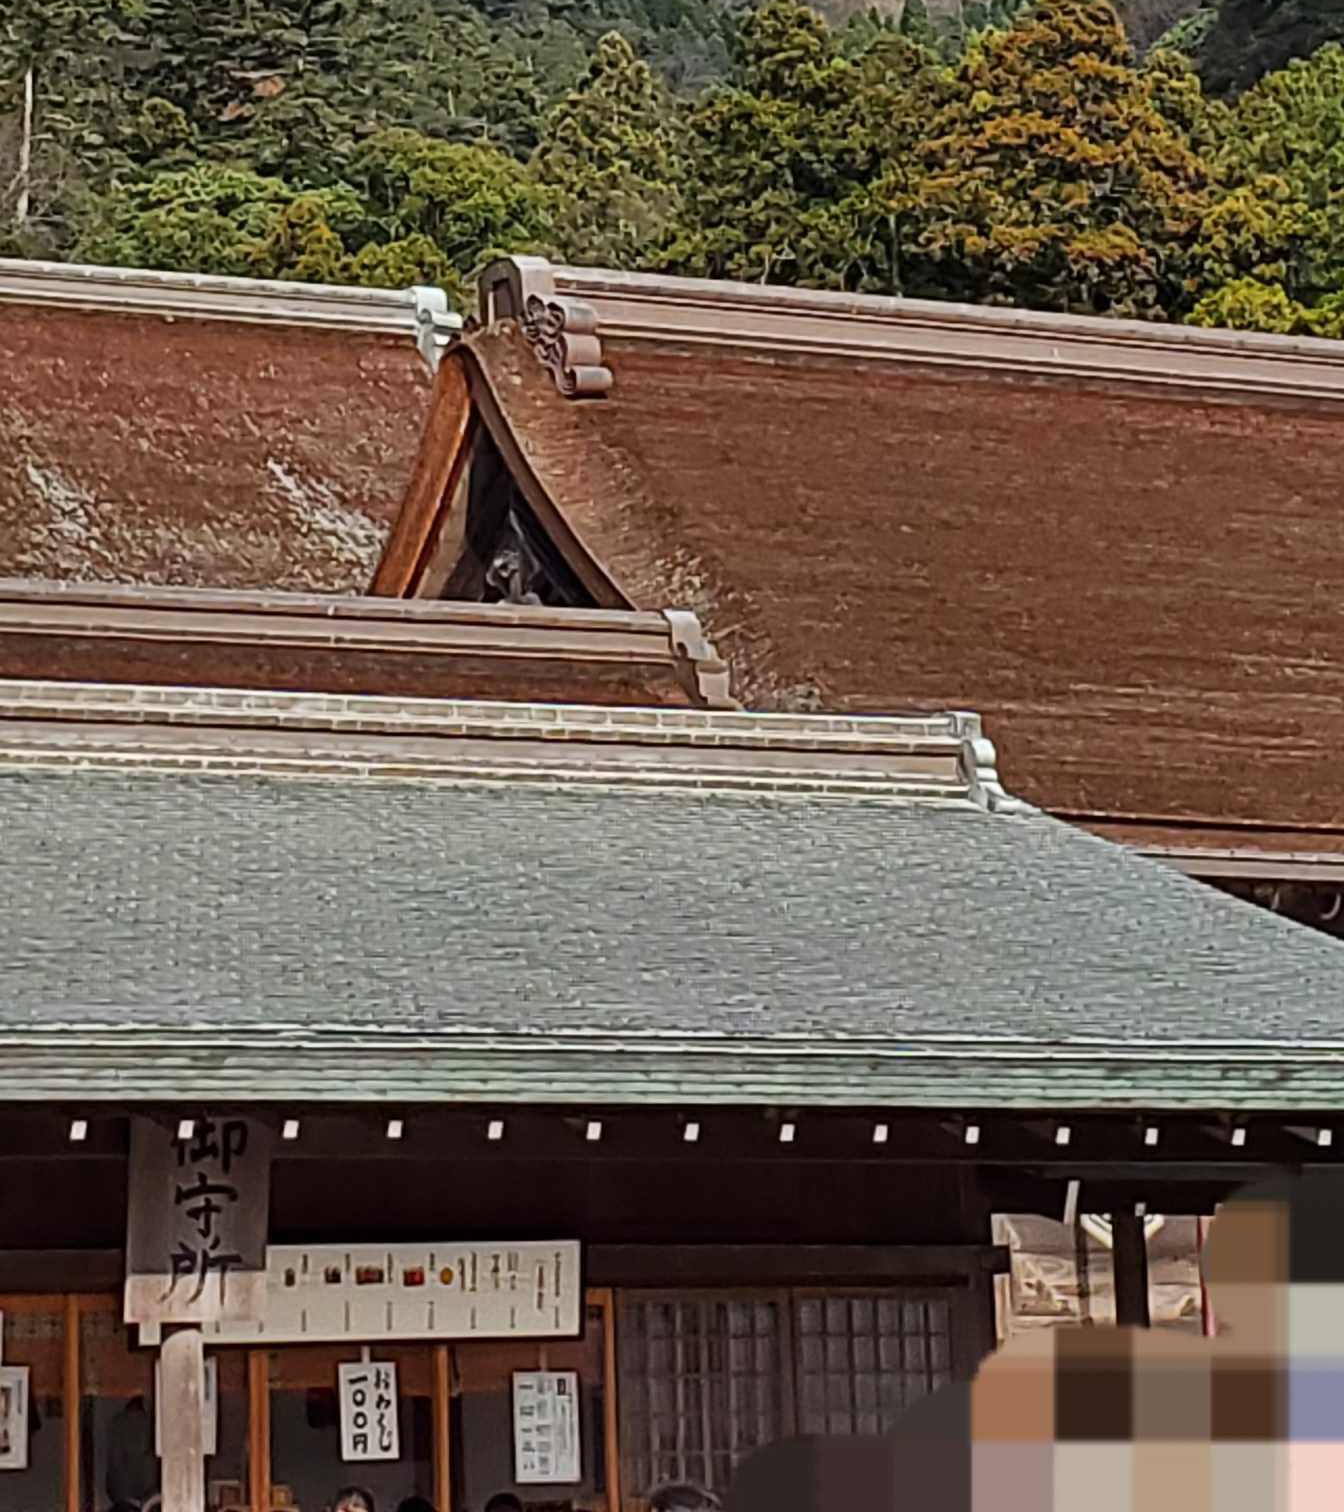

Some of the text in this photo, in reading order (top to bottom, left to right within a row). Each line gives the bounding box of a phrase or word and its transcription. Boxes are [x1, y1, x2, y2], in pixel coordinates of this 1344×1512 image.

[159, 1113, 248, 1305] 御守所
[373, 1368, 393, 1452] おみくじ
